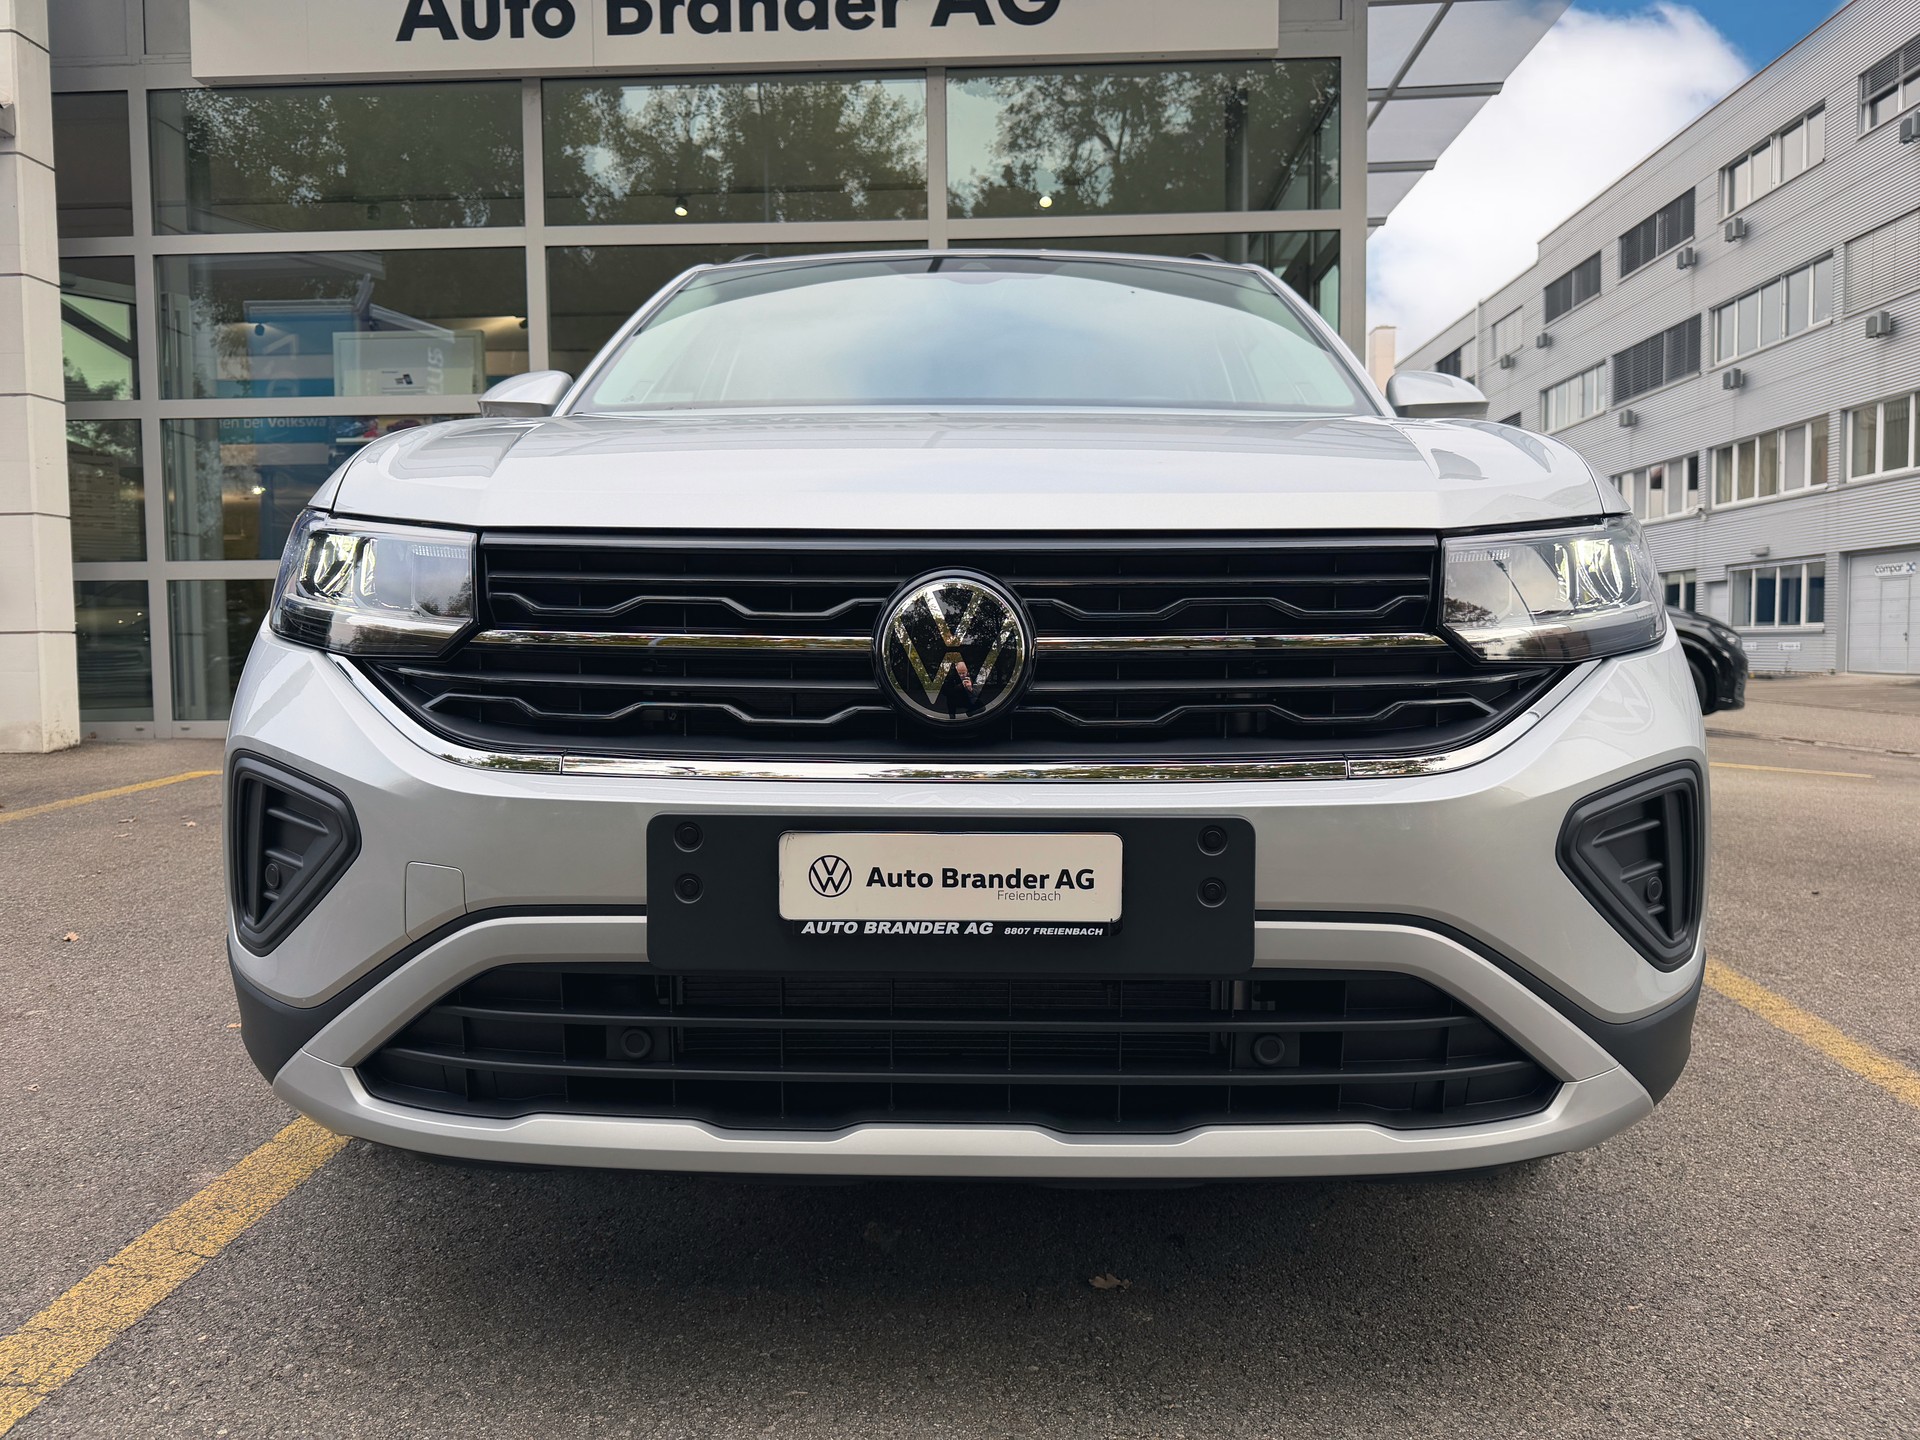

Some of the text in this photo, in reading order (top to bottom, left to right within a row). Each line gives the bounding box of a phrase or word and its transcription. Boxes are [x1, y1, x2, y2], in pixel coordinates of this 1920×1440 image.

[395, 0, 575, 41] Auto
[606, 0, 897, 36] Brander
[866, 867, 934, 888] Auto
[942, 868, 1050, 889] Brander
[1055, 869, 1095, 890] AG
[997, 890, 1061, 901] Freienbach
[801, 921, 1104, 936] AUTO BRANDER AG 8807 FREIENBACH
